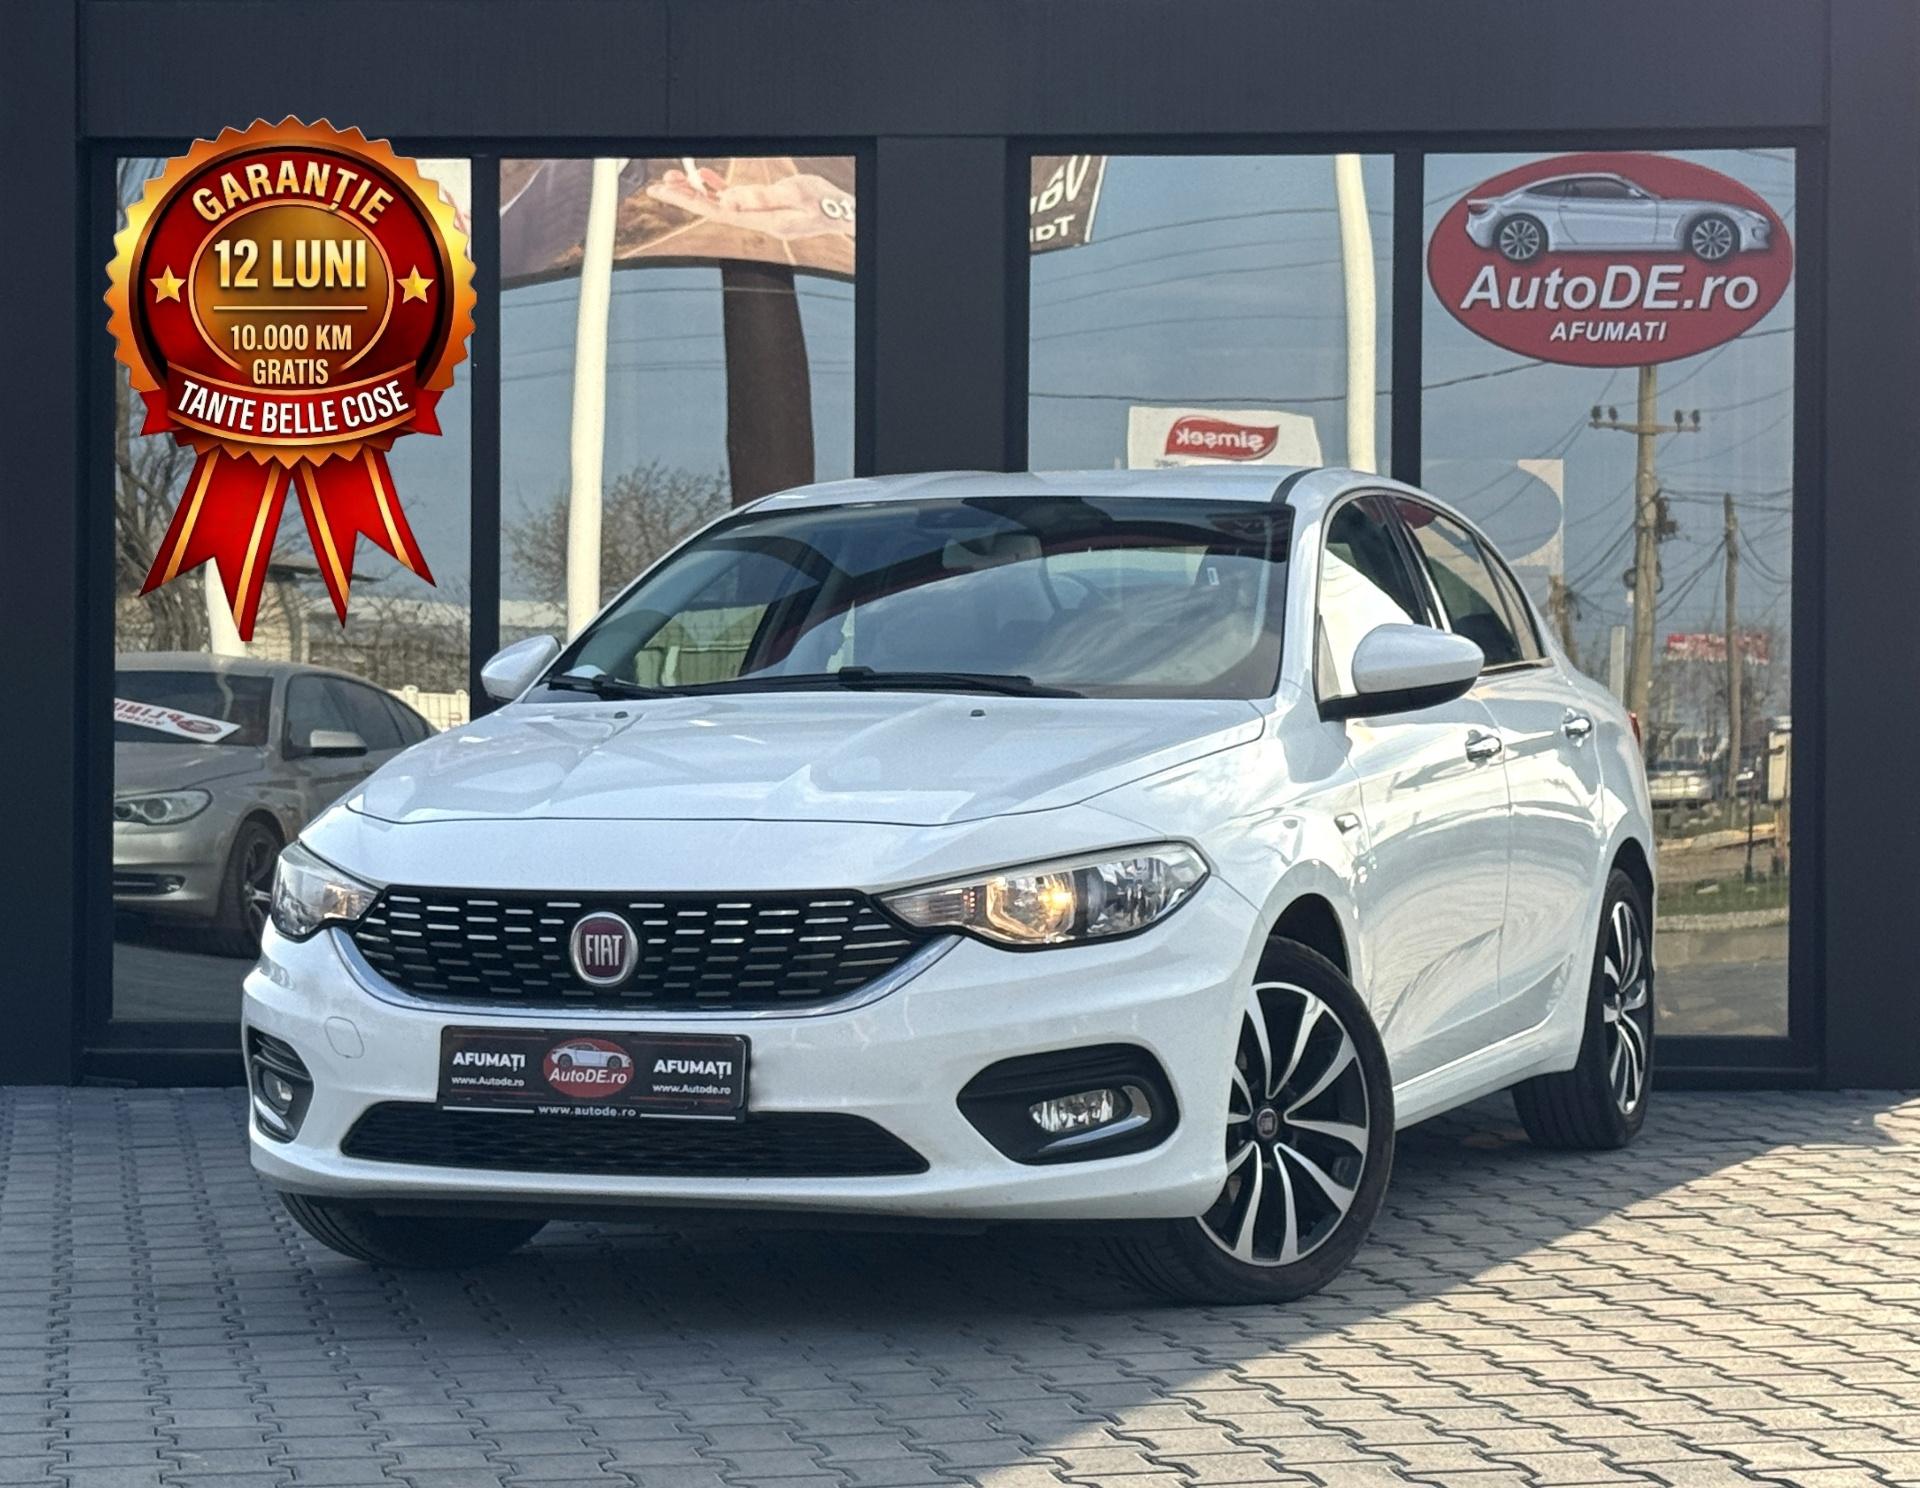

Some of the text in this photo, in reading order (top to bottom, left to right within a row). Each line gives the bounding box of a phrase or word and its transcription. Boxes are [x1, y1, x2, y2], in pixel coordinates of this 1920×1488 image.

[1460, 264, 1759, 311] AutoDE.ro
[1550, 321, 1667, 342] AFUMATI
[584, 934, 623, 967] FIAT
[452, 1052, 526, 1072] AFUMAȚI
[653, 1059, 732, 1079] AFUMAȚI
[451, 1076, 525, 1087] www.Autode.ro
[549, 1067, 628, 1085] AutoDE.ro
[652, 1083, 732, 1095] www.Autode.ro
[538, 1105, 637, 1117] www.autode.ro
